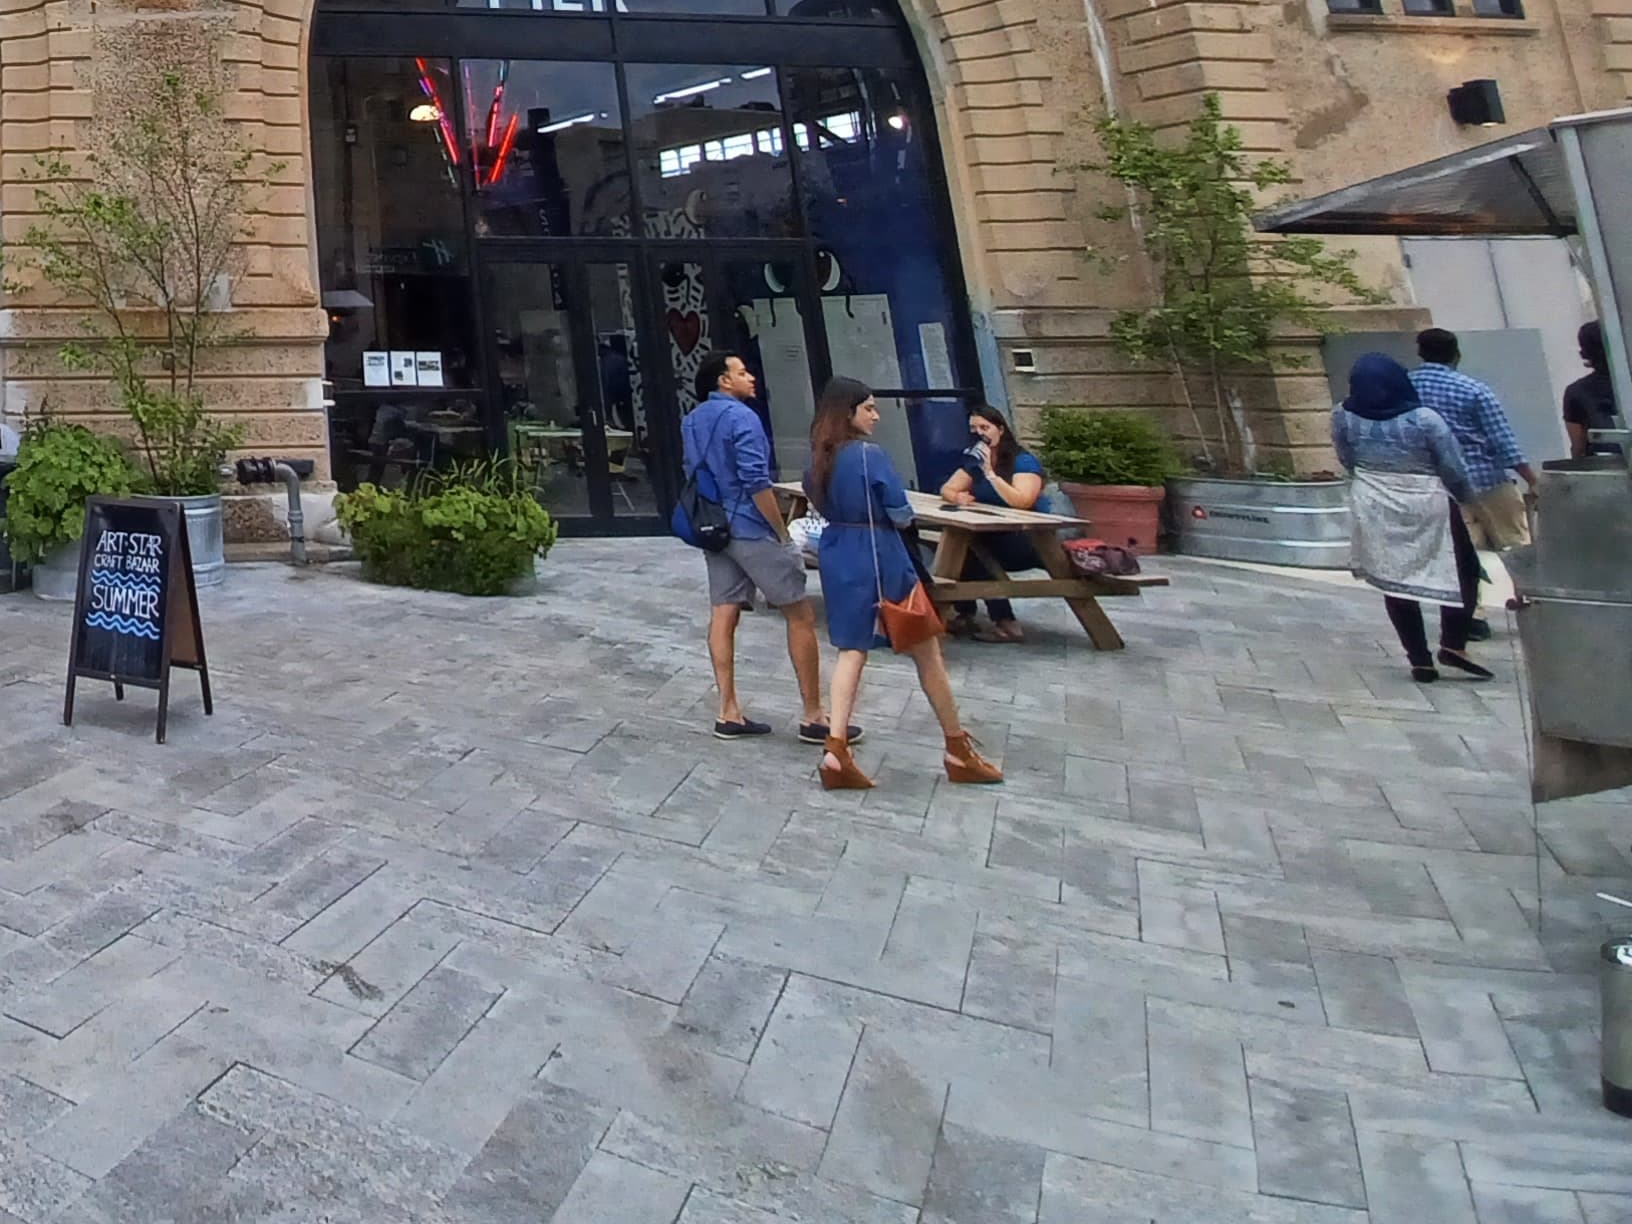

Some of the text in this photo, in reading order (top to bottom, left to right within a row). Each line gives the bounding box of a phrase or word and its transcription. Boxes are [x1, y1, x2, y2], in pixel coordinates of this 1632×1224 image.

[94, 554, 160, 573] CRAFT BAZAAR
[91, 584, 160, 619] SUMMER
